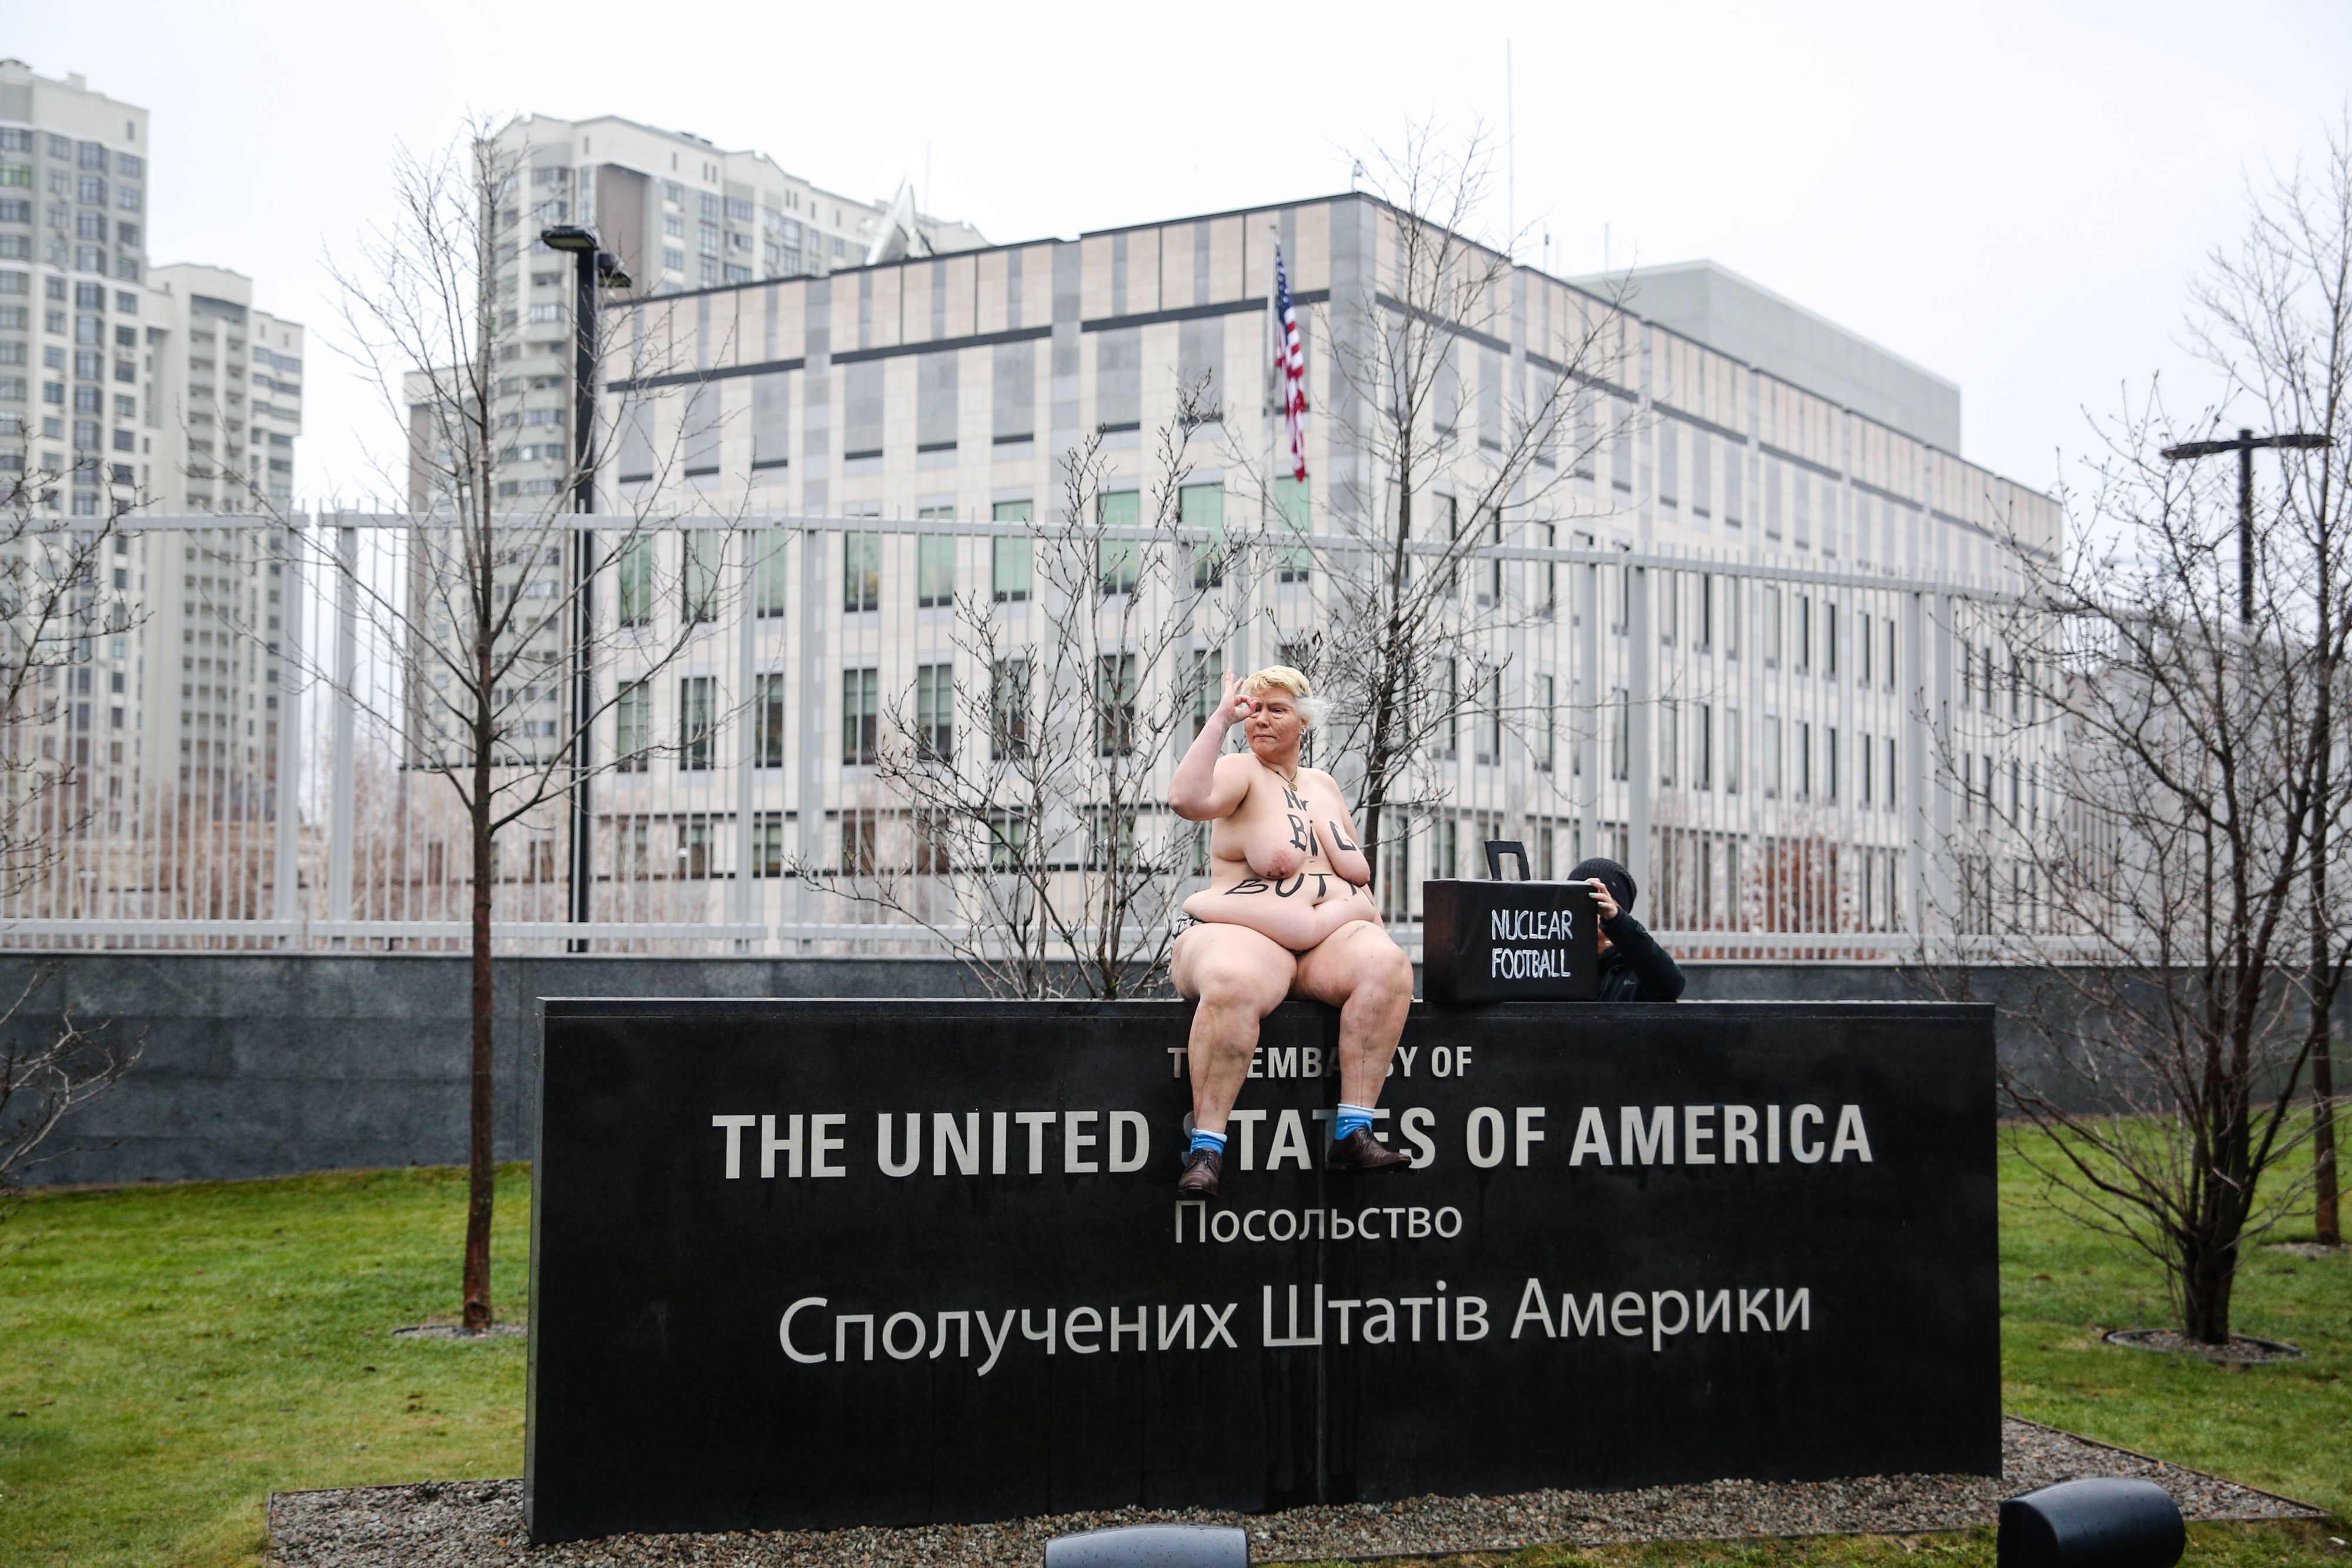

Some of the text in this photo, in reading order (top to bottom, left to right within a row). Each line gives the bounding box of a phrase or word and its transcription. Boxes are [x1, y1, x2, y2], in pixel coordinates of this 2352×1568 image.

[1282, 786, 1309, 811] Mr
[1491, 909, 1573, 941] NUCLEAR
[1491, 947, 1572, 979] FOOTBALL
[1431, 1045, 1472, 1078] OF
[712, 1114, 847, 1179] THE
[877, 1110, 1150, 1177] UNITED
[1466, 1106, 1546, 1169] OF
[1569, 1104, 1873, 1166] AMERICA
[1175, 1199, 1463, 1243] Посольство
[779, 1277, 1810, 1377] Сполучених Штатів Америки
